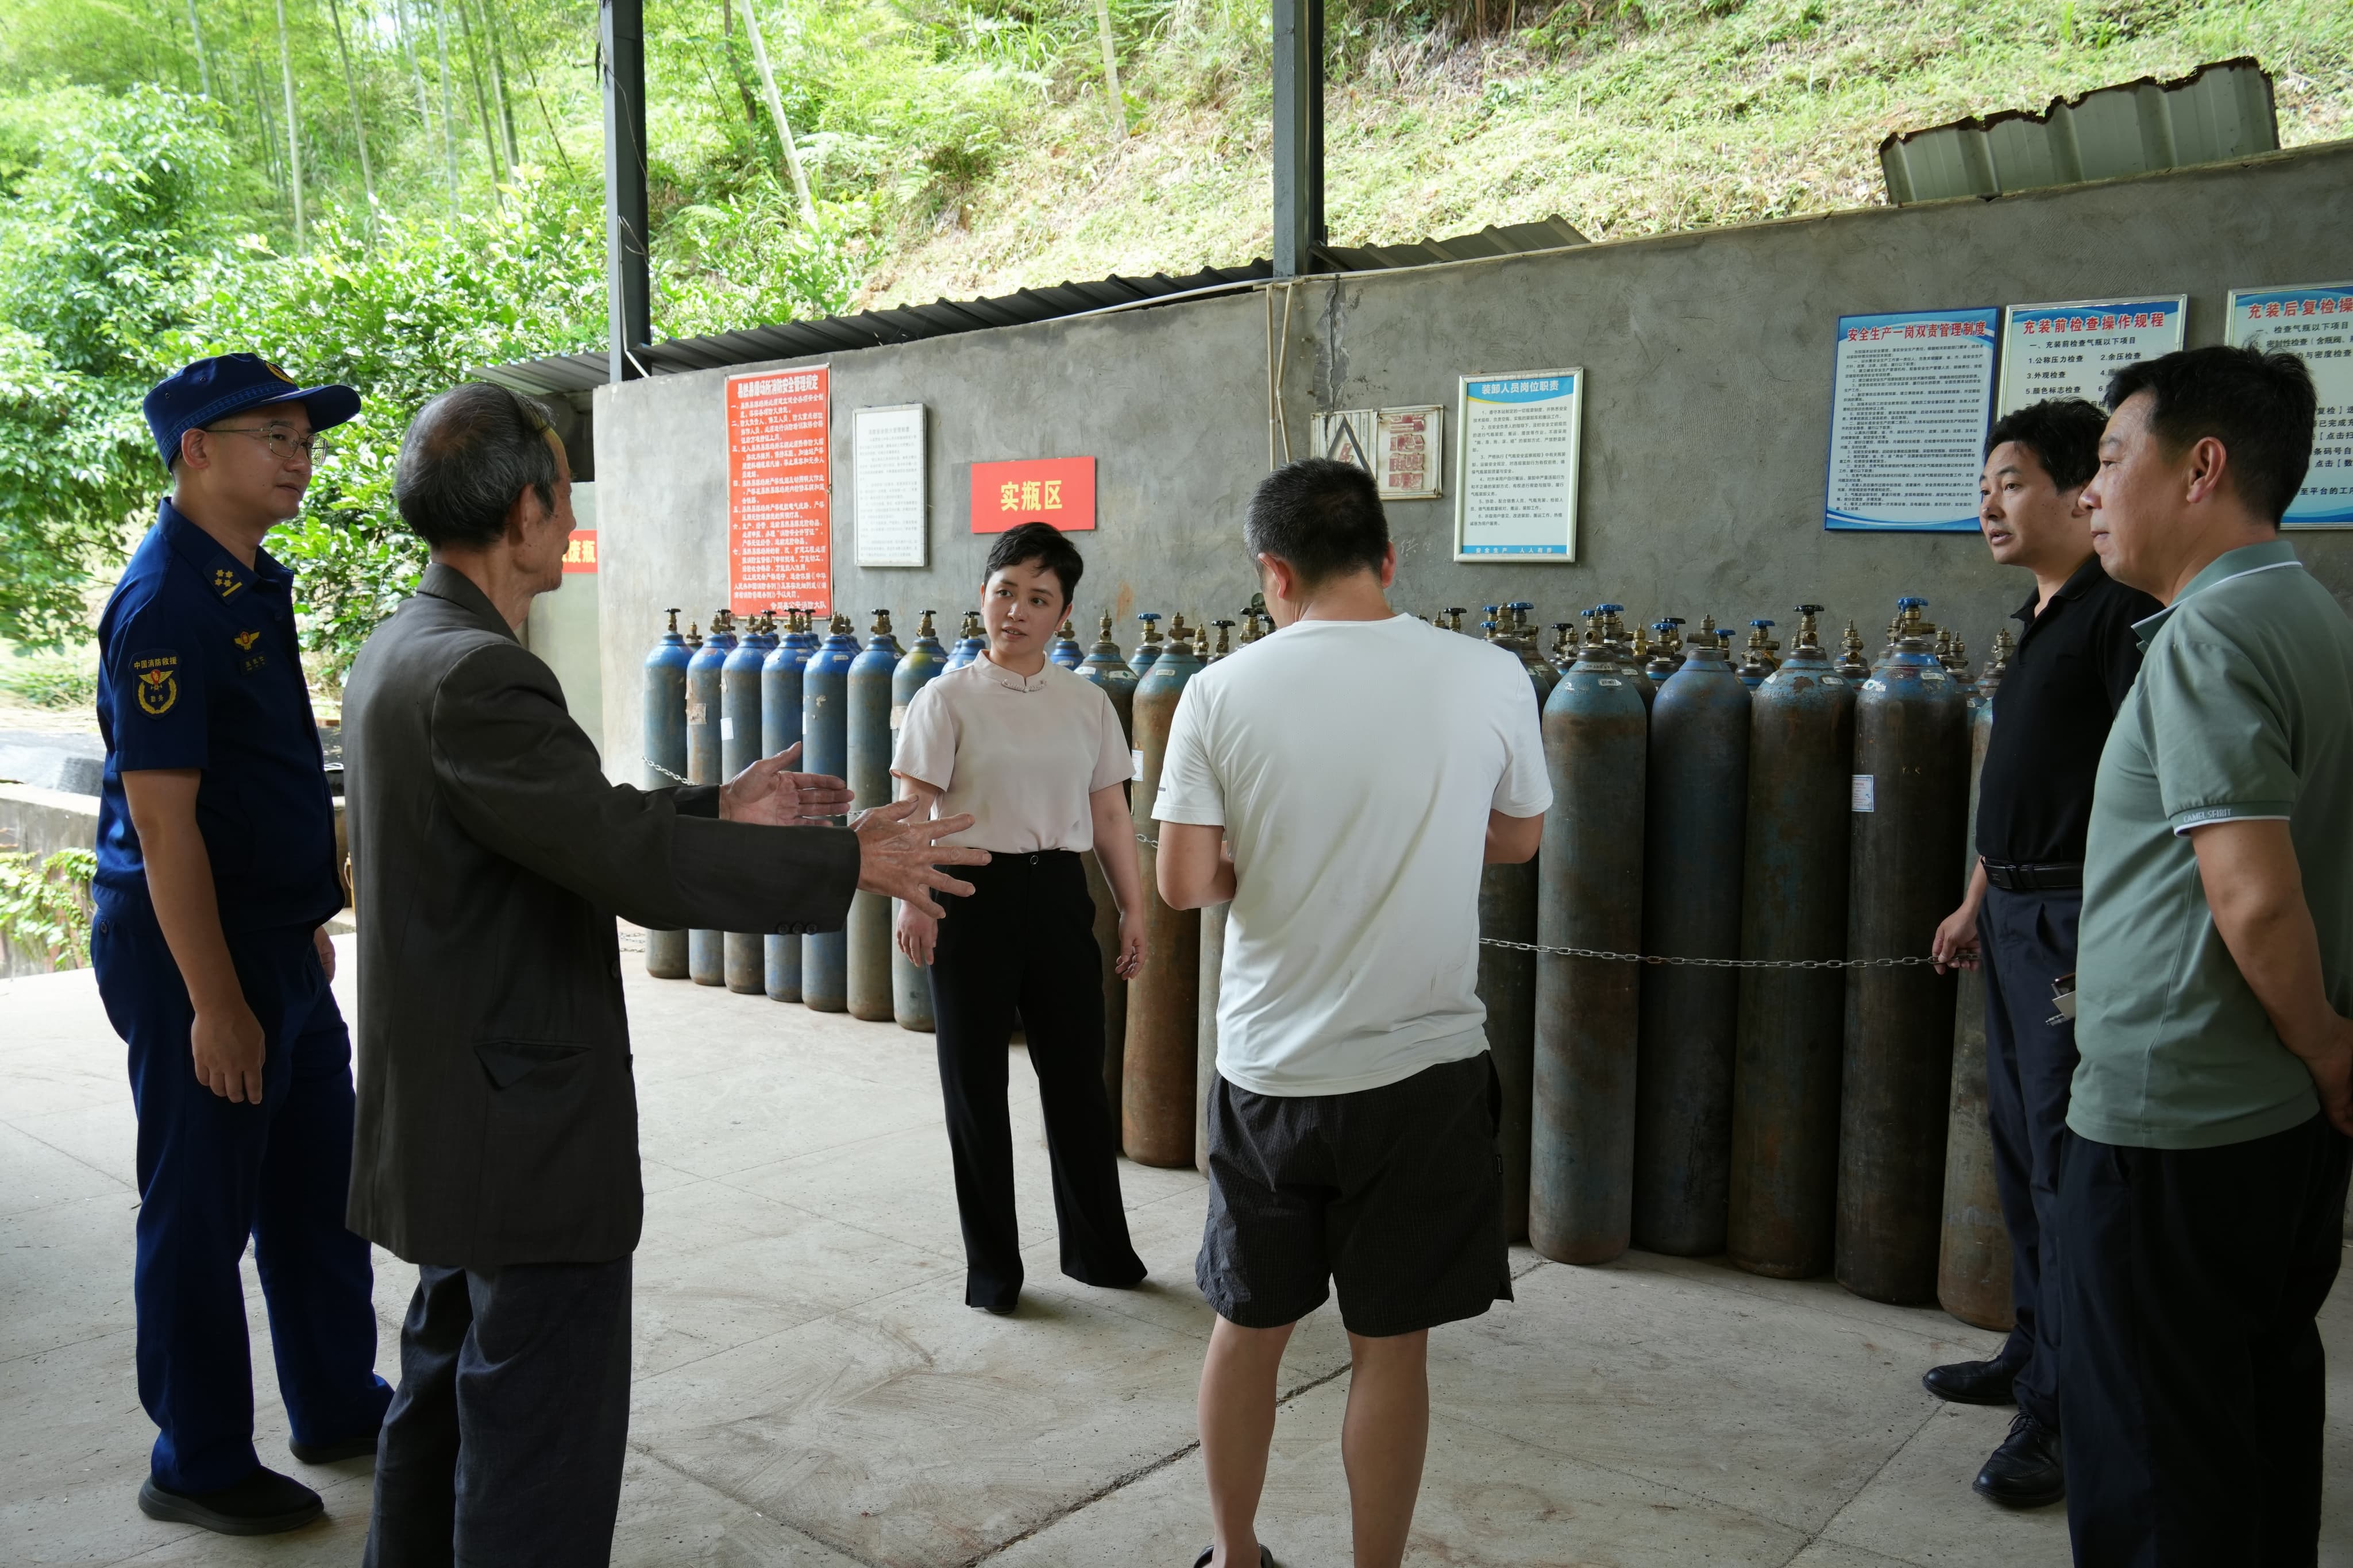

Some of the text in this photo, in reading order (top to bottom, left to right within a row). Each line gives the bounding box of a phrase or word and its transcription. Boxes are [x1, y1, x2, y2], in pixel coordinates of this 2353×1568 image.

[2248, 297, 2353, 319] 充装后复检操
[1847, 320, 1986, 342] 安全生产一岗双责管理制度
[2023, 312, 2165, 335] 充装前检查操作规程
[2028, 352, 2142, 364] 1.公称压力检查 2.余压检查
[1481, 380, 1559, 396] 装卸人员岗位职责
[2026, 386, 2082, 395] 5.颜色标志检查
[1000, 480, 1063, 512] 实瓶区
[134, 656, 178, 670] 中国消防救援
[2184, 811, 2206, 823] CAMEL
